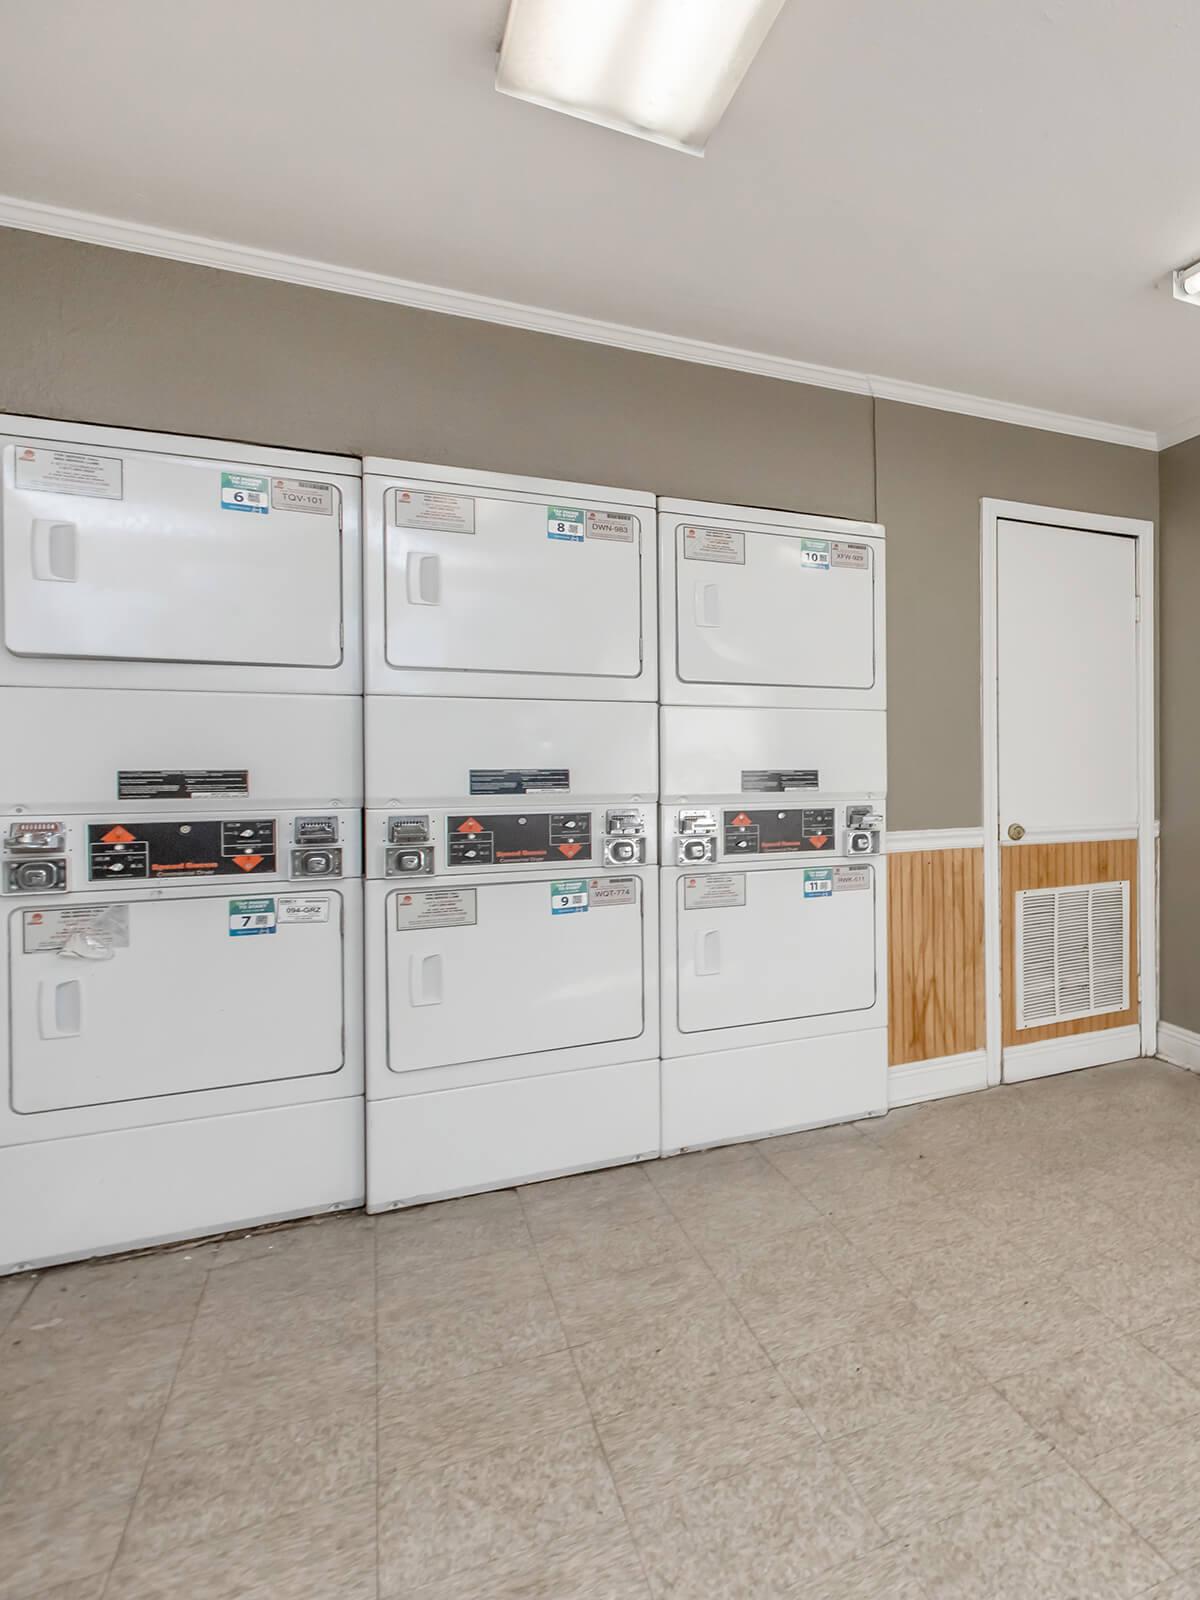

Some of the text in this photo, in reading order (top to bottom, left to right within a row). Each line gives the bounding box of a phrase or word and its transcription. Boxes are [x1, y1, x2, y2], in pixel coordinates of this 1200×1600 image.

[234, 492, 244, 502] 6
[282, 493, 322, 504] TQV-101
[557, 523, 565, 532] 8
[806, 553, 818, 561] 10
[809, 882, 818, 891] 11
[594, 889, 630, 897] WQT-774
[561, 896, 569, 906] 9
[241, 916, 252, 927] 7
